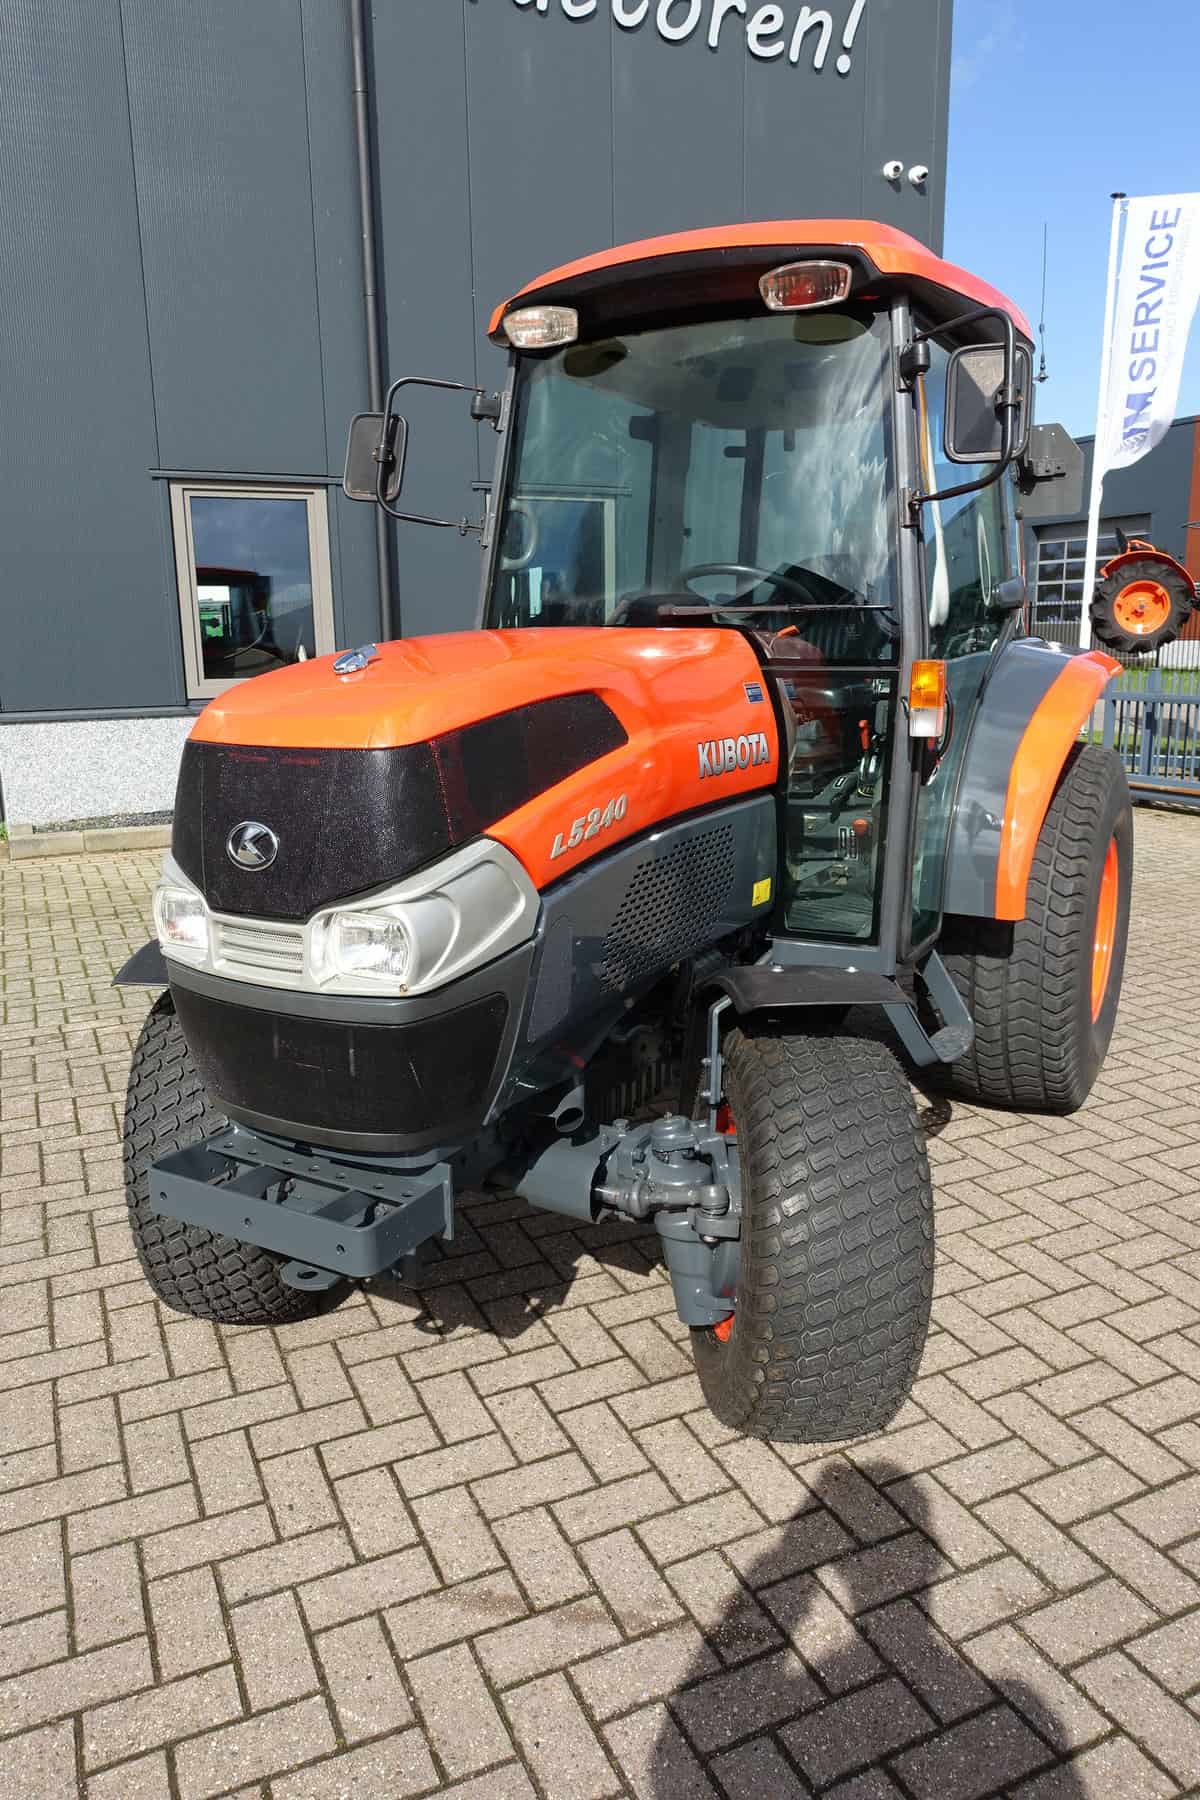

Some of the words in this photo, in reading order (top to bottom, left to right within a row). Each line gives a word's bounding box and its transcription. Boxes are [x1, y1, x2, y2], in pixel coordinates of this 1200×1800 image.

[1129, 207, 1182, 382] SERVICE
[697, 732, 770, 779] KUBOTA
[550, 792, 629, 860] L5240
